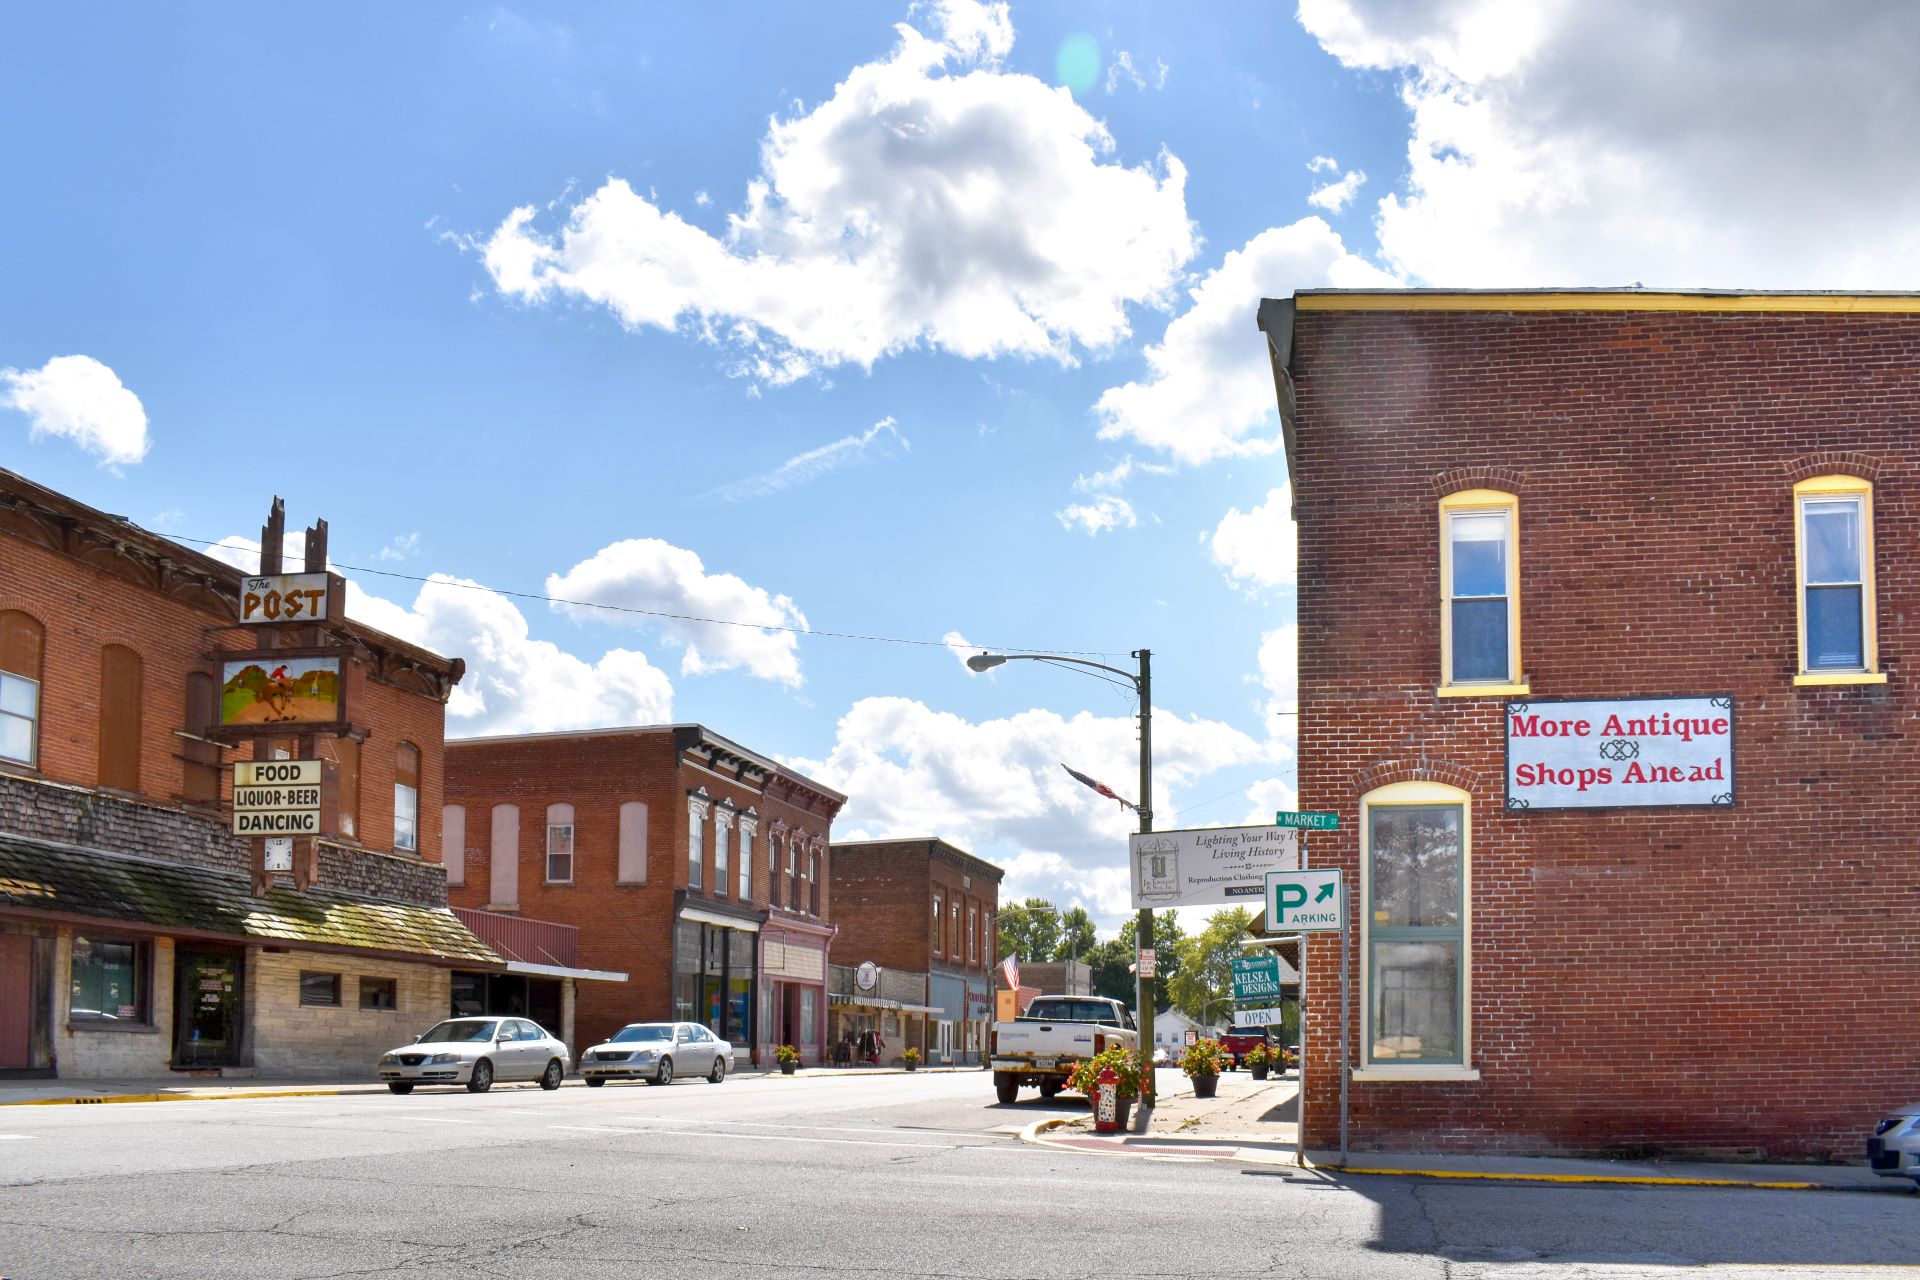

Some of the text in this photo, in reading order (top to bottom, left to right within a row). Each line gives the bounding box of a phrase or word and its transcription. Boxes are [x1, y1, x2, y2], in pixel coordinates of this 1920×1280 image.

[247, 577, 270, 591] The
[243, 589, 325, 620] POST
[1510, 712, 1729, 742] More Antique
[255, 765, 301, 781] FOOD
[1516, 762, 1613, 792] Shops
[236, 789, 319, 806] LIQUOR-BEER
[239, 814, 314, 831] DANCING
[1285, 814, 1326, 827] MARKET
[1195, 834, 1238, 849] Lighting
[1241, 833, 1264, 843] Your
[1266, 831, 1286, 844] Way
[1212, 846, 1285, 861] Living History
[1188, 874, 1264, 885] Reproduction Clothing
[1276, 883, 1336, 924] PARKING
[1234, 970, 1271, 986] KELSEA
[1242, 981, 1278, 995] DESIGNS
[1244, 1011, 1272, 1025] OPEN
